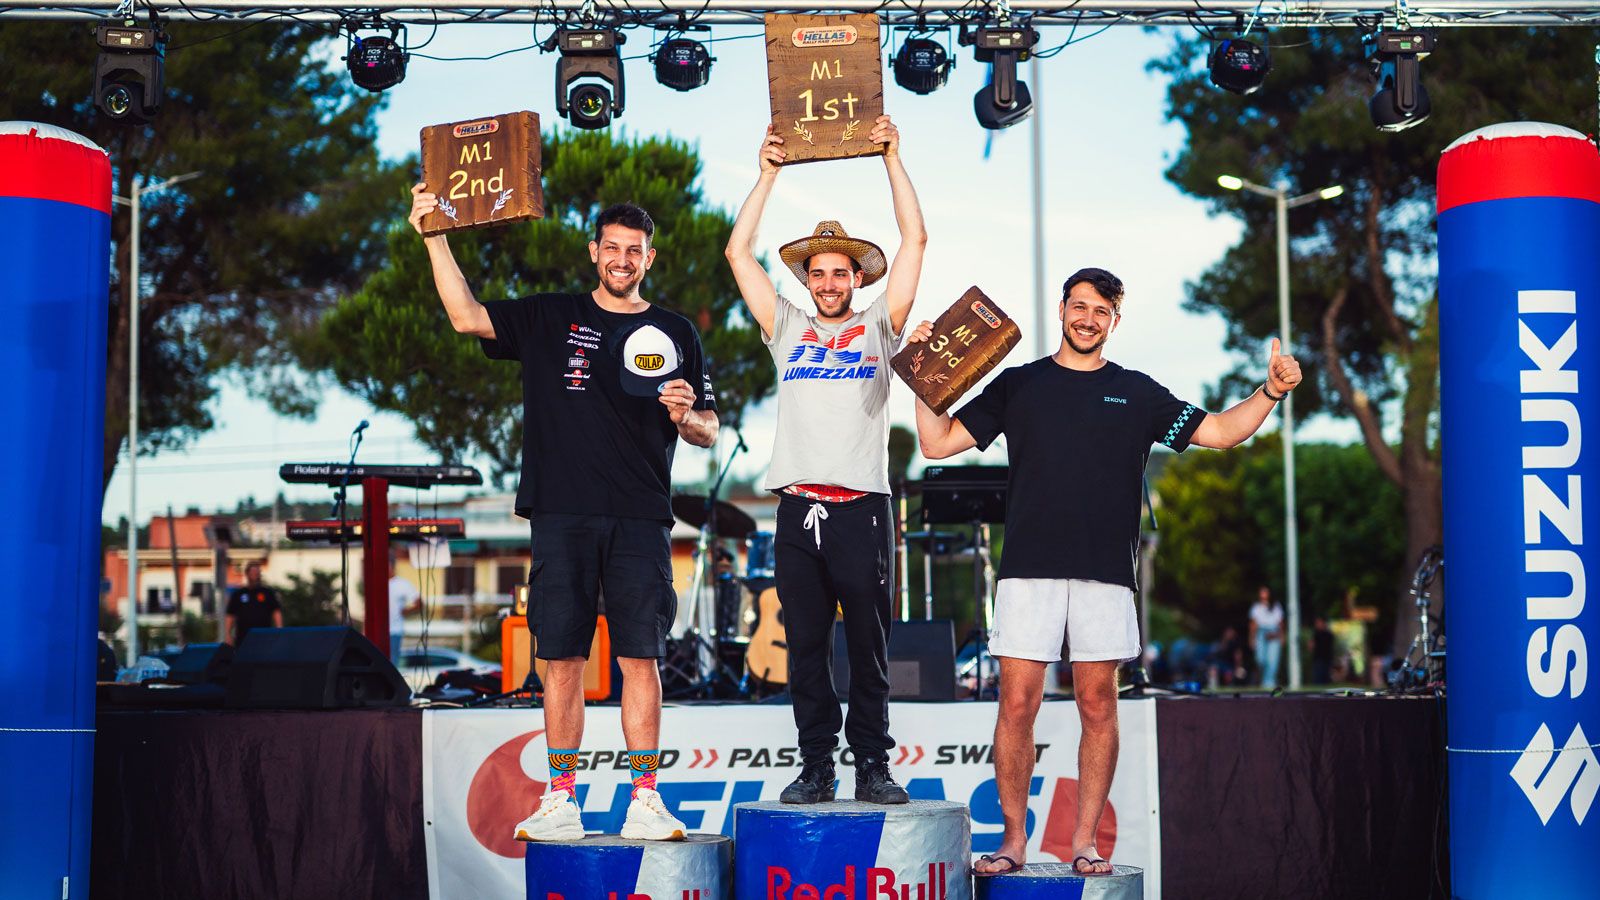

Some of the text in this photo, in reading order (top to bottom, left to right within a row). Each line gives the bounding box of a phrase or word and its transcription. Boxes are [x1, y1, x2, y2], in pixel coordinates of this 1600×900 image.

[804, 31, 845, 41] HELLAS
[811, 59, 843, 81] M1
[798, 89, 859, 122] 1st
[461, 124, 490, 134] HELLAS
[460, 141, 493, 165] M1
[449, 168, 504, 200] 2nd
[951, 324, 978, 347] M1
[638, 356, 662, 369] ZULAP
[929, 334, 965, 369] 3rd
[783, 366, 877, 381] LUMEZZANE
[294, 464, 330, 475] Roland
[1517, 290, 1589, 699] SUZUKI
[573, 749, 680, 771] SPED
[934, 743, 1050, 765] SWT
